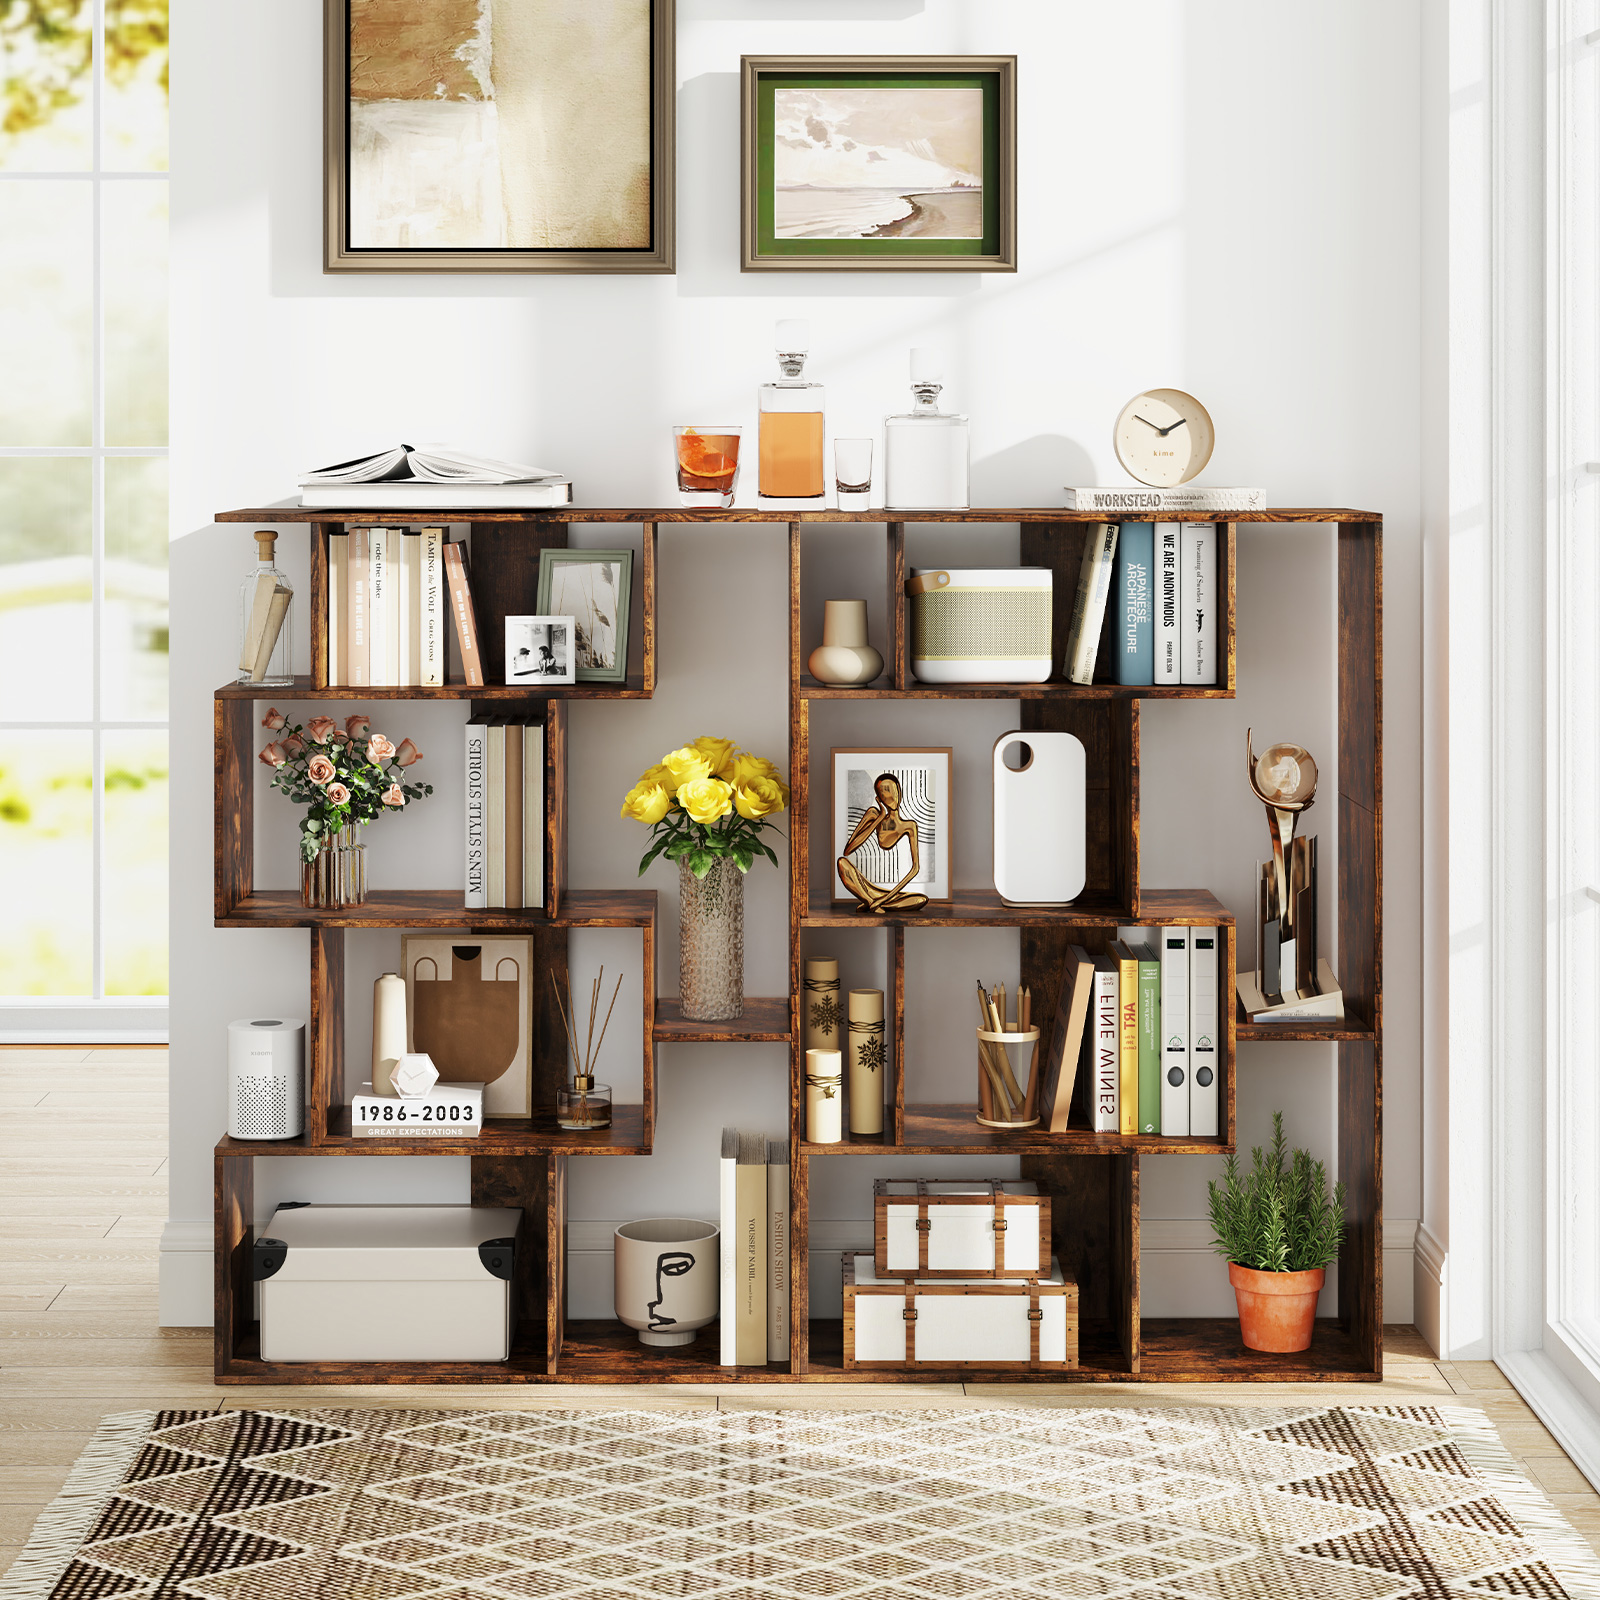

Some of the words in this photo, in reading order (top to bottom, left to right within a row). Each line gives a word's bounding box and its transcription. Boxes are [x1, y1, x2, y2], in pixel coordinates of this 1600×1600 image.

[1094, 494, 1161, 507] WORKSTEAD
[428, 534, 437, 572] TAMING
[1163, 534, 1174, 548] WE
[1195, 540, 1203, 570] Dreaming
[1163, 550, 1174, 568] ARE
[356, 595, 363, 604] DO
[428, 586, 436, 614] WOLF
[458, 604, 464, 612] DO
[1127, 562, 1137, 653] ARCHITECTURE
[1136, 563, 1146, 623] JAPANESE
[1163, 571, 1174, 627] ANONYMOUS
[356, 605, 363, 614] WE
[460, 614, 466, 623] WE
[469, 738, 482, 799] STORIES
[469, 802, 482, 846] STYLE
[469, 850, 482, 894] MEN'S
[367, 1128, 396, 1136] GREAT
[399, 1128, 464, 1136] EXPECTATIONS
[775, 1211, 784, 1257] FASHION
[775, 1260, 784, 1291] SHOW
